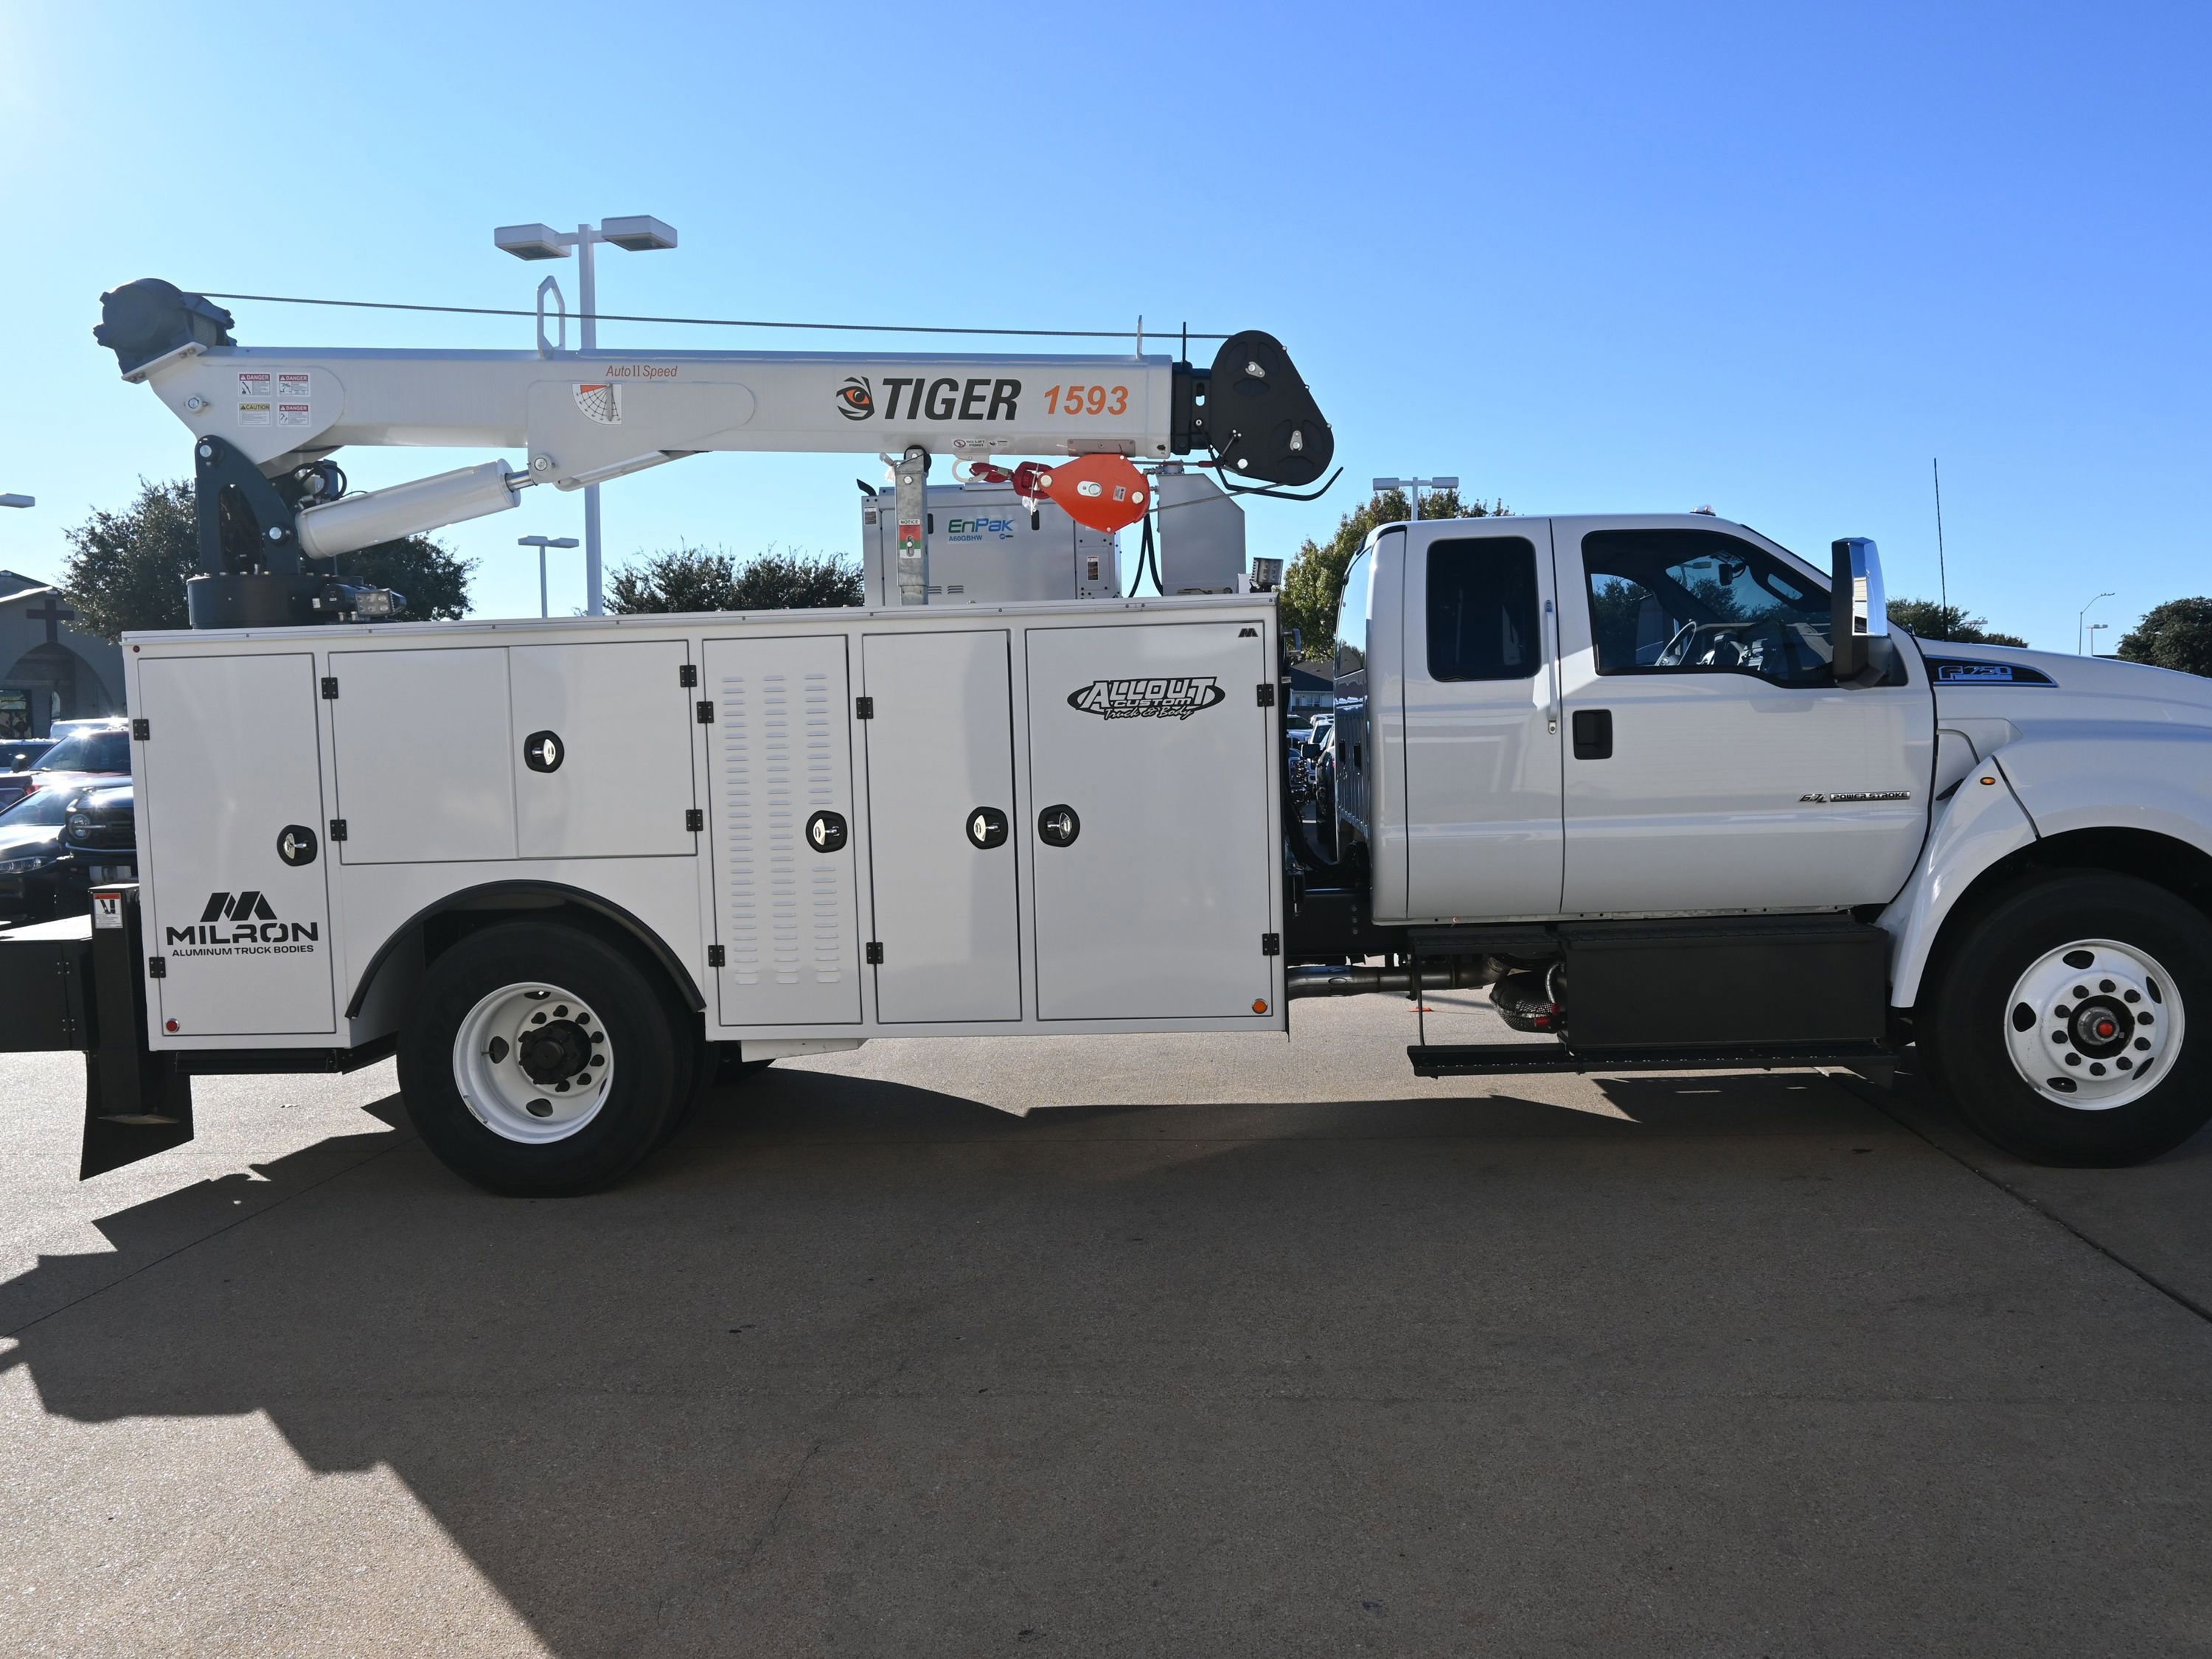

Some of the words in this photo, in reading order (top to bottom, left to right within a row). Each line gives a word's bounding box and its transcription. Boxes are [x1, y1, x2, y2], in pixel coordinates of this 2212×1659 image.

[605, 365, 630, 377] Auto
[642, 365, 678, 379] Speed
[882, 378, 1022, 420] TIGER
[1043, 385, 1129, 415] 1593
[948, 518, 1015, 533] EnPak
[1077, 677, 1217, 709] ALLOUT
[1113, 698, 1192, 707] CUSTOM
[1104, 708, 1140, 720] Truck
[1142, 707, 1156, 717] &
[1158, 706, 1192, 720] Body
[166, 922, 319, 945] MILRON
[172, 948, 232, 956] ALUMINUM
[234, 947, 271, 955] TRUCK
[274, 945, 314, 953] BODIES
